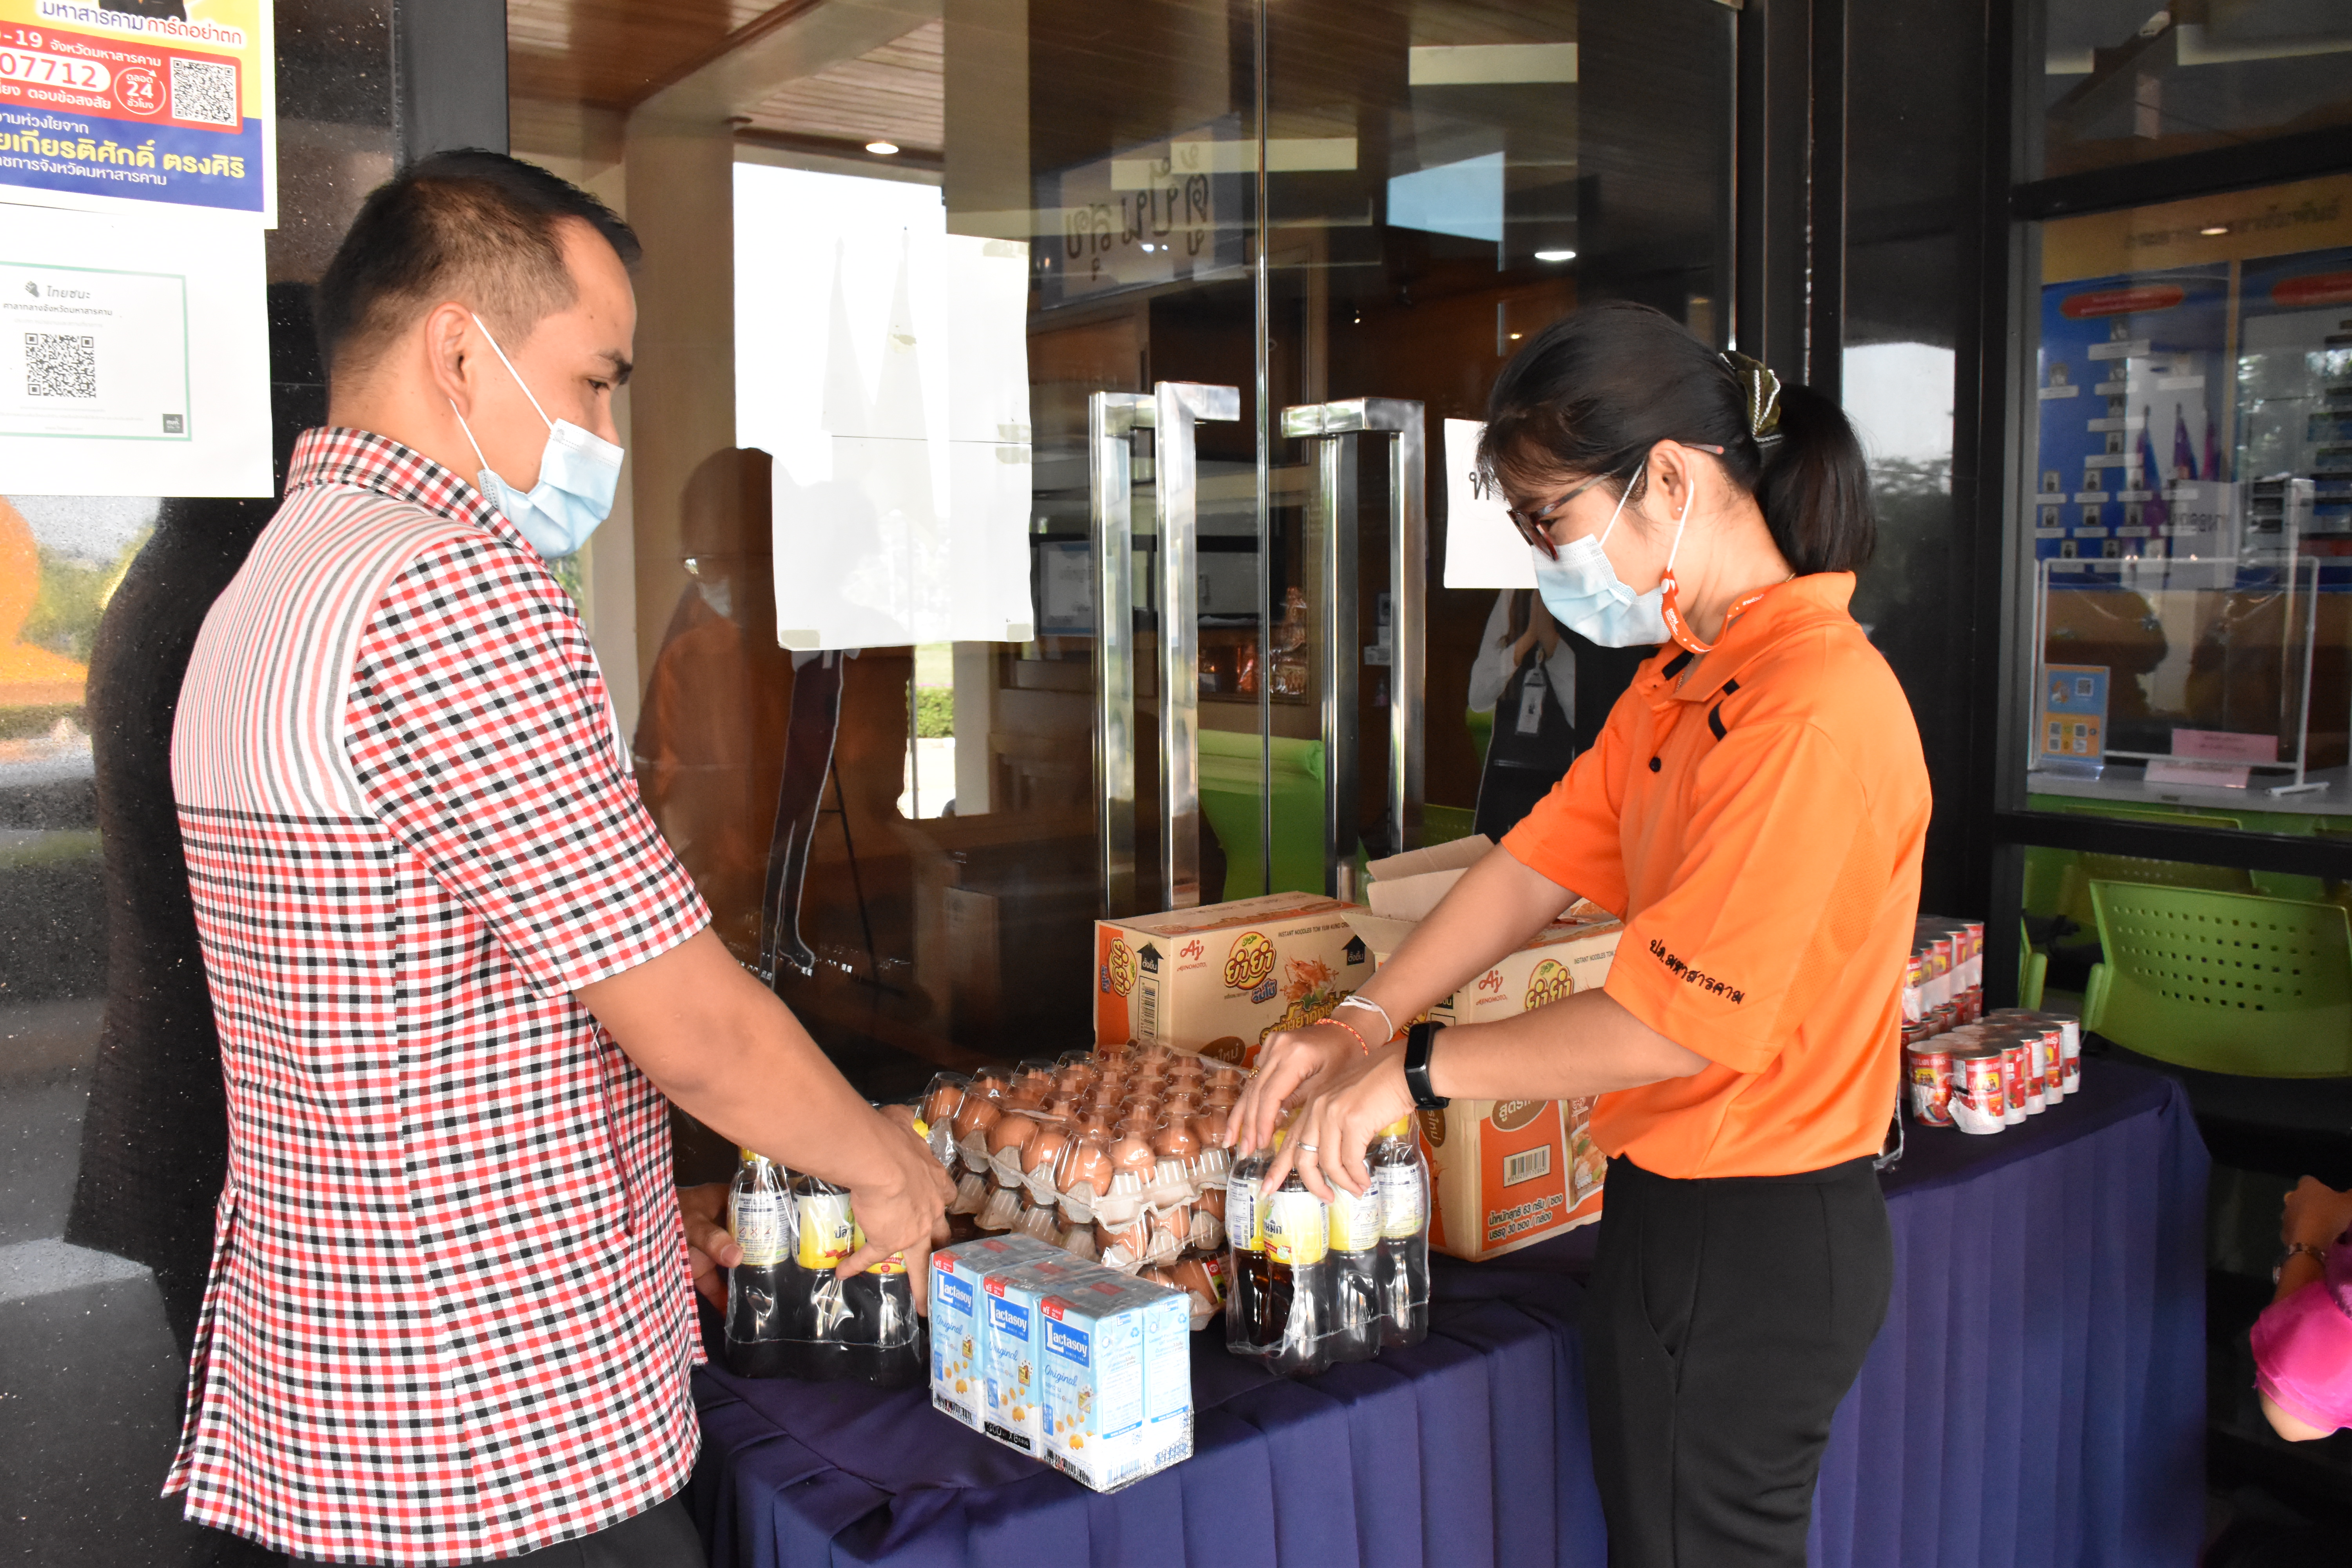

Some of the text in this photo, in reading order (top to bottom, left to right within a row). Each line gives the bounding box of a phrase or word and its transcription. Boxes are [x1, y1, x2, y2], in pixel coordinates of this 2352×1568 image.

[42, 1, 242, 45] มหาสารคาม การ์ดอย่าตก
[0, 29, 161, 67] -19 จังหวัดมหาสารคาม
[127, 74, 153, 83] ตลอด
[28, 89, 111, 110] ตอบข้อสงสัย
[127, 81, 153, 98] 24
[127, 94, 154, 109] ชั่วโมง
[163, 154, 245, 178] ตรงศิริ
[46, 284, 91, 299] ไทยชนะ
[3, 302, 113, 316] ศาลากลางจังหวัดมหาสารคาม
[1142, 957, 1157, 971] ตั้งขึ้น
[1225, 940, 1275, 985] ยำยำ
[1574, 956, 1589, 964] INSTANT
[1590, 954, 1606, 962] NOODLES
[1523, 1204, 1530, 1214] 63
[1532, 1199, 1544, 1211] กรัม
[1551, 1194, 1563, 1205] ซอง
[1508, 1224, 1515, 1234] 30
[1536, 1211, 1552, 1223] กล่อง
[938, 1274, 971, 1307] Lactasoy
[936, 1315, 963, 1335] Original
[989, 1298, 1027, 1332] Lactasoy
[1046, 1321, 1087, 1357] Lactasoy
[989, 1341, 1018, 1361] Original
[1045, 1364, 1078, 1387] Original
